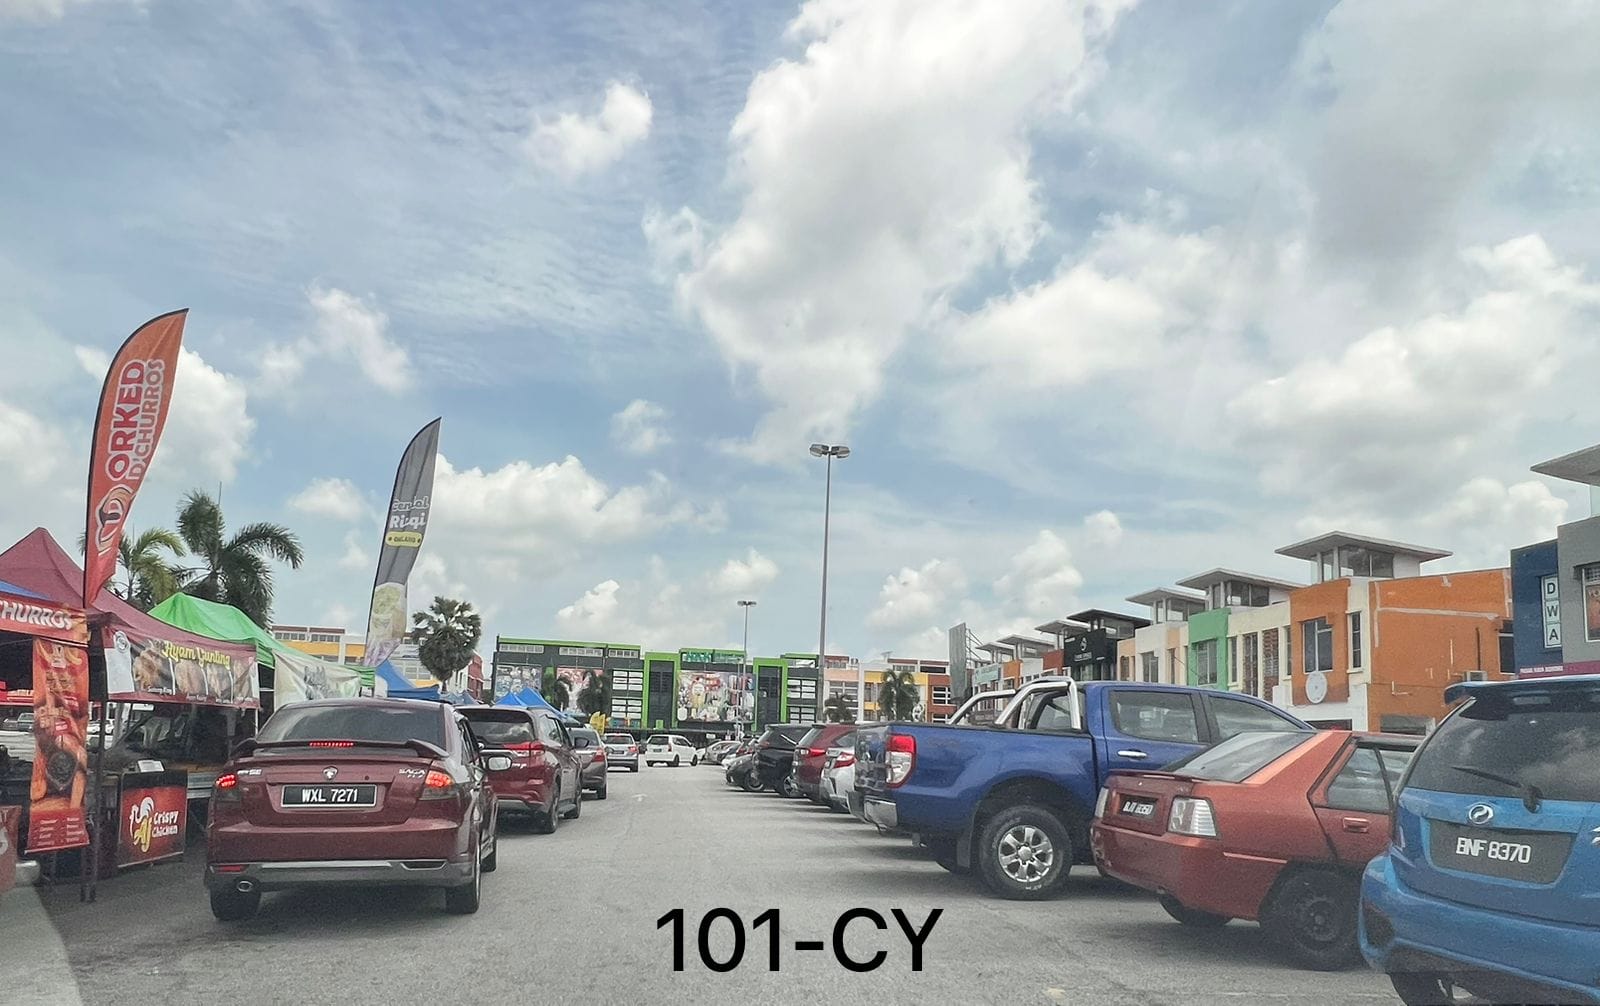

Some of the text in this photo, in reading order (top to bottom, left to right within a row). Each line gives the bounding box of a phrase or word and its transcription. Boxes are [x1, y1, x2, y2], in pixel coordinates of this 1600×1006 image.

[106, 360, 146, 481] ORKED
[127, 358, 165, 480] D'CHURROS
[0, 600, 72, 630] HURROS
[302, 788, 358, 802] WXL 7271
[1456, 837, 1532, 864] BNF 8370
